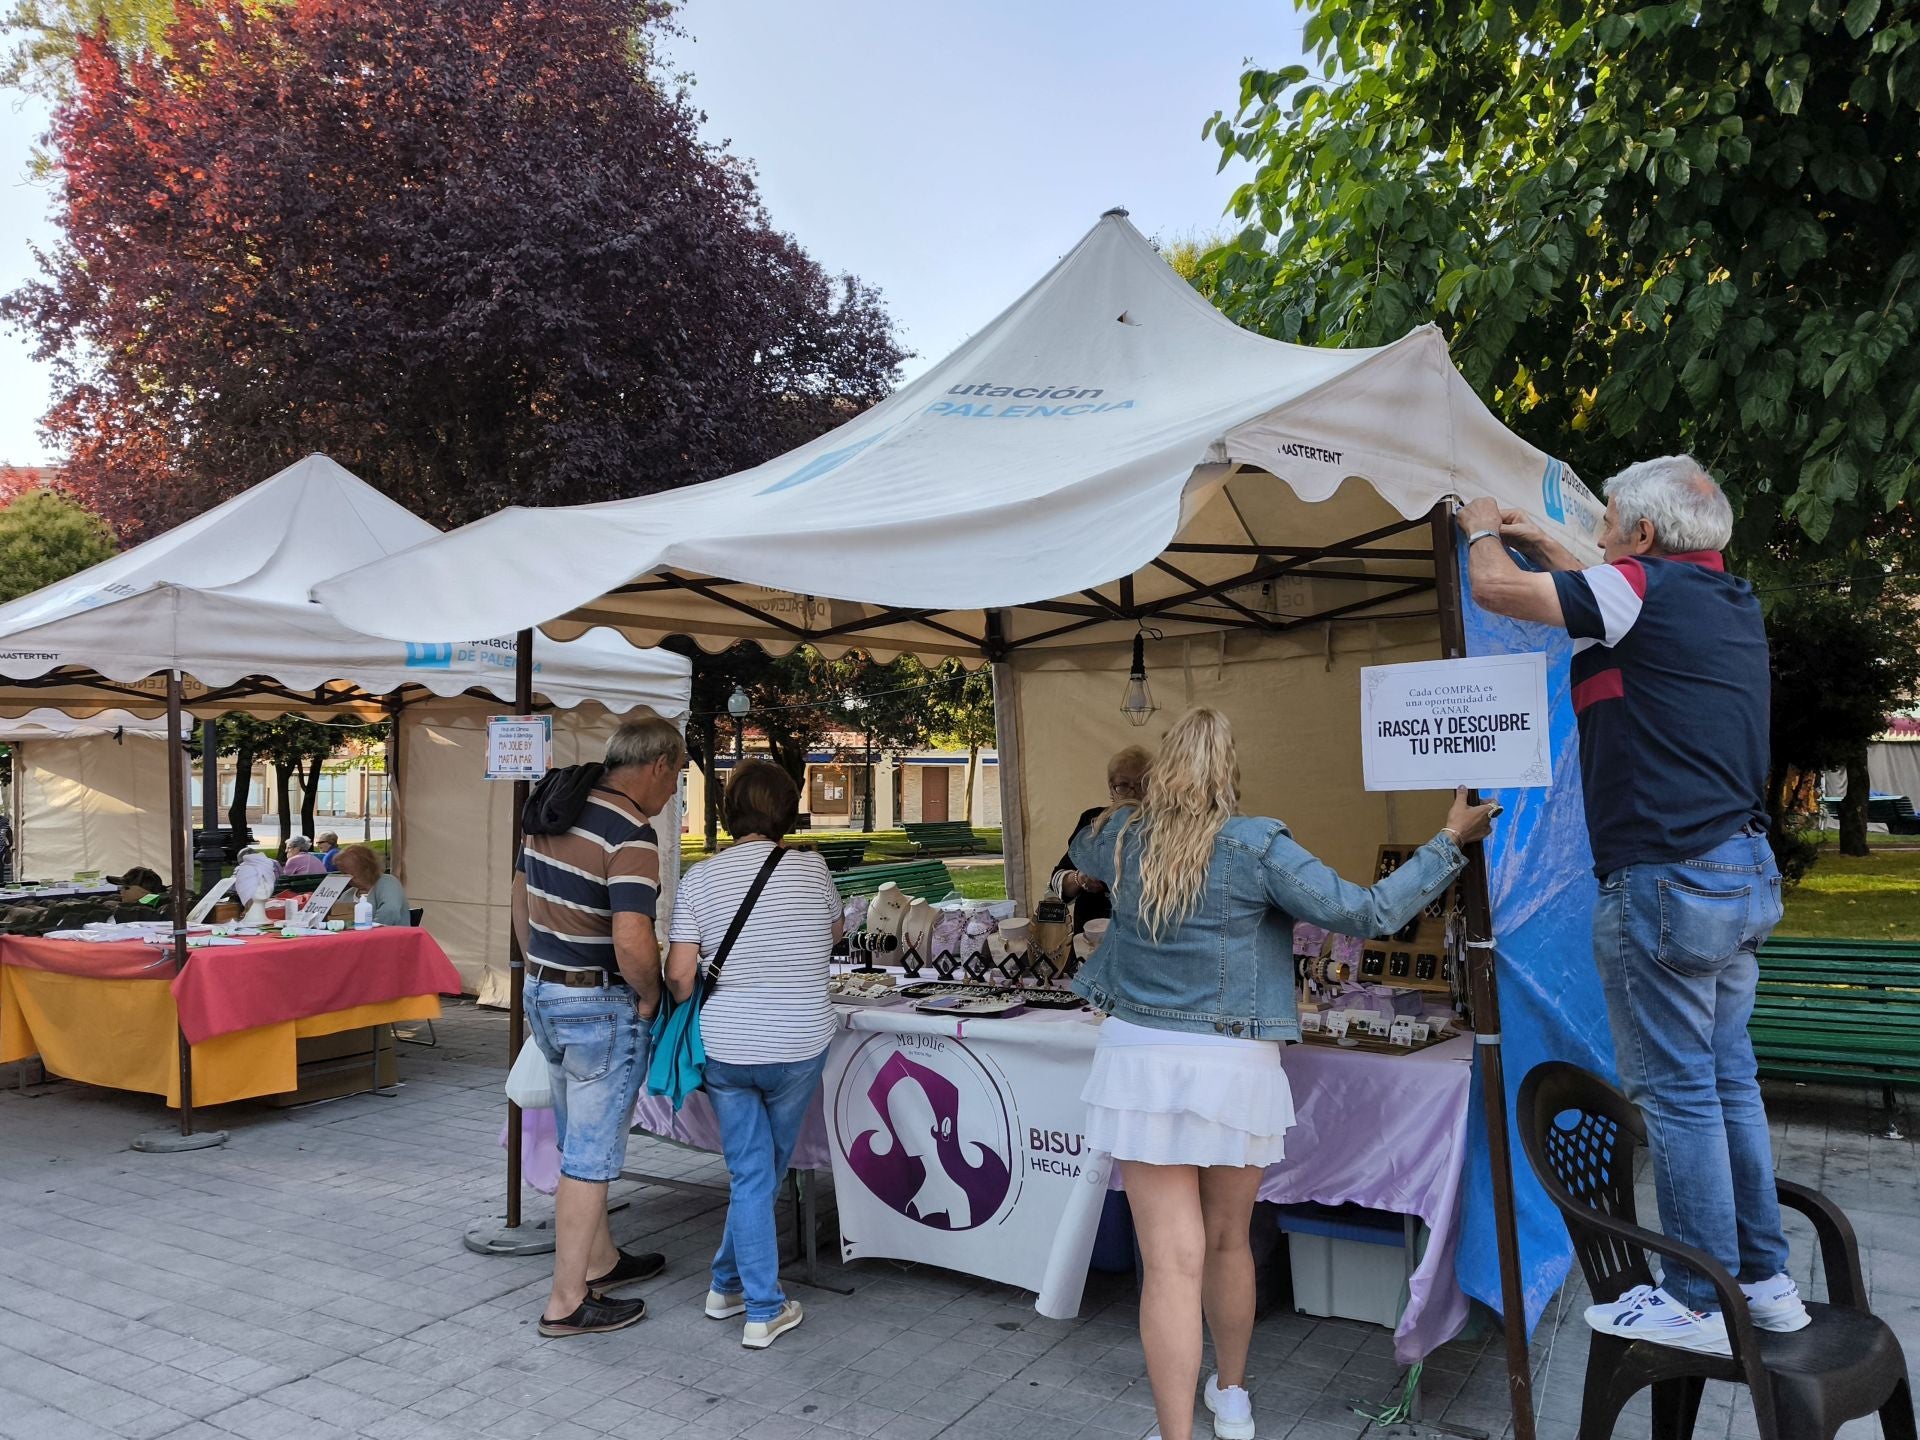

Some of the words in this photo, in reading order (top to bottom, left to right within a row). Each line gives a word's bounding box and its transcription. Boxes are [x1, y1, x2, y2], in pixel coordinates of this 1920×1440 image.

[947, 382, 1104, 400] utación
[922, 399, 1135, 418] PALENCIA
[458, 650, 476, 662] DE
[1409, 688, 1432, 697] Cada
[1435, 684, 1481, 696] COMPRA
[1425, 696, 1483, 707] oportunidad
[1486, 694, 1497, 702] de
[1432, 706, 1470, 715] GANAR
[1378, 719, 1431, 738] ¡RASCA
[1434, 718, 1444, 734] Y
[1448, 713, 1530, 734] DESCUBRE
[1409, 738, 1429, 755] TU
[1433, 735, 1496, 754] PREMIO!
[316, 887, 338, 898] Aloe
[305, 902, 328, 913] Vera
[896, 1033, 914, 1047] Ma
[916, 1033, 945, 1052] Jolie
[1029, 1127, 1086, 1157] BISU
[1030, 1156, 1081, 1178] HECHA
